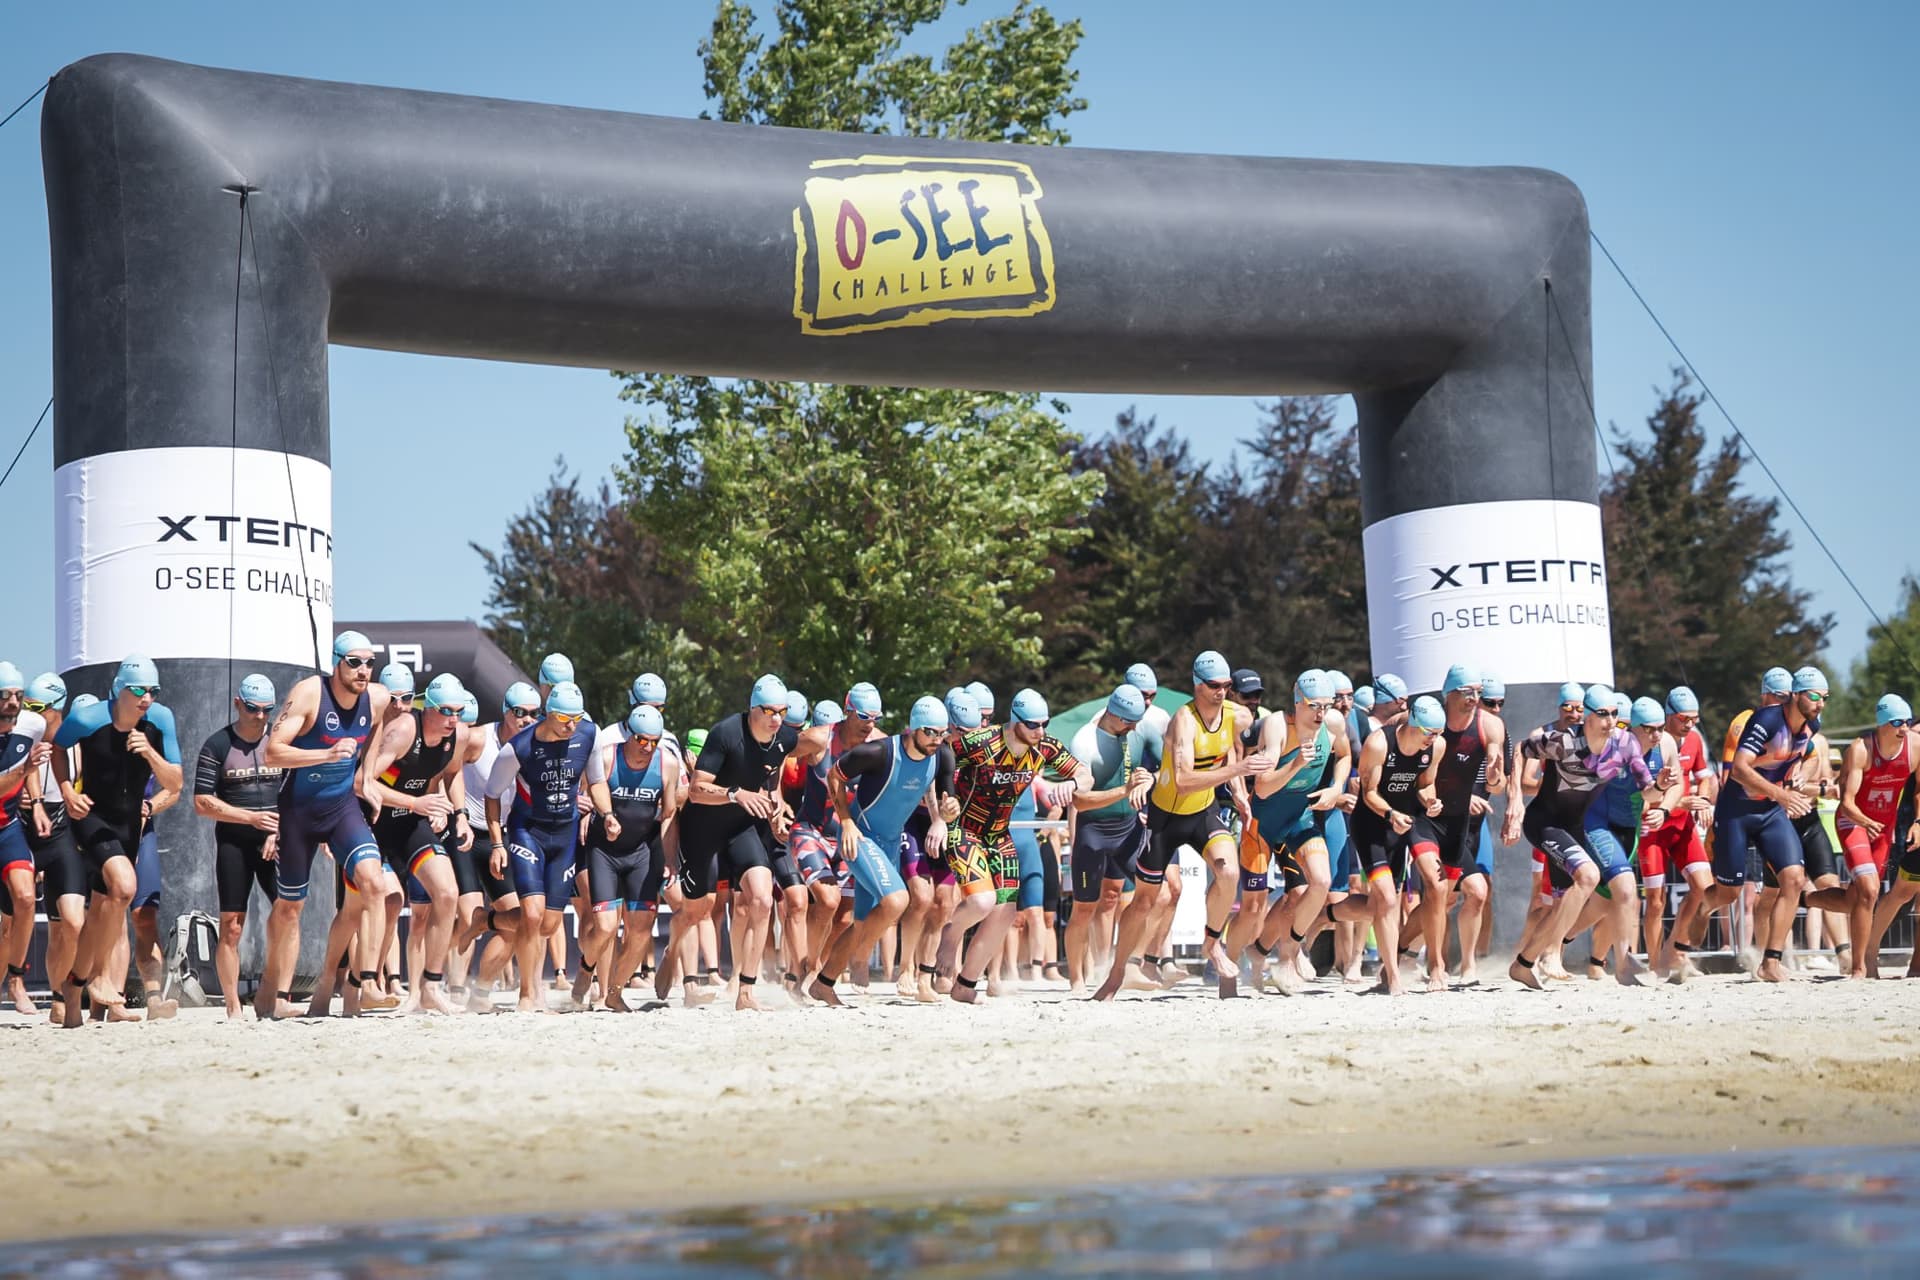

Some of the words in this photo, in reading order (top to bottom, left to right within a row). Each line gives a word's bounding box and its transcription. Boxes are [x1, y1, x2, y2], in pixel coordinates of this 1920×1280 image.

[835, 179, 1014, 271] O-SEE
[833, 259, 1018, 300] CHALLENGE
[155, 566, 236, 590] O-SEE
[1431, 605, 1500, 631] O-SEE
[404, 779, 427, 789] GER
[992, 771, 1032, 784] ROOTS
[1387, 782, 1409, 792] GER
